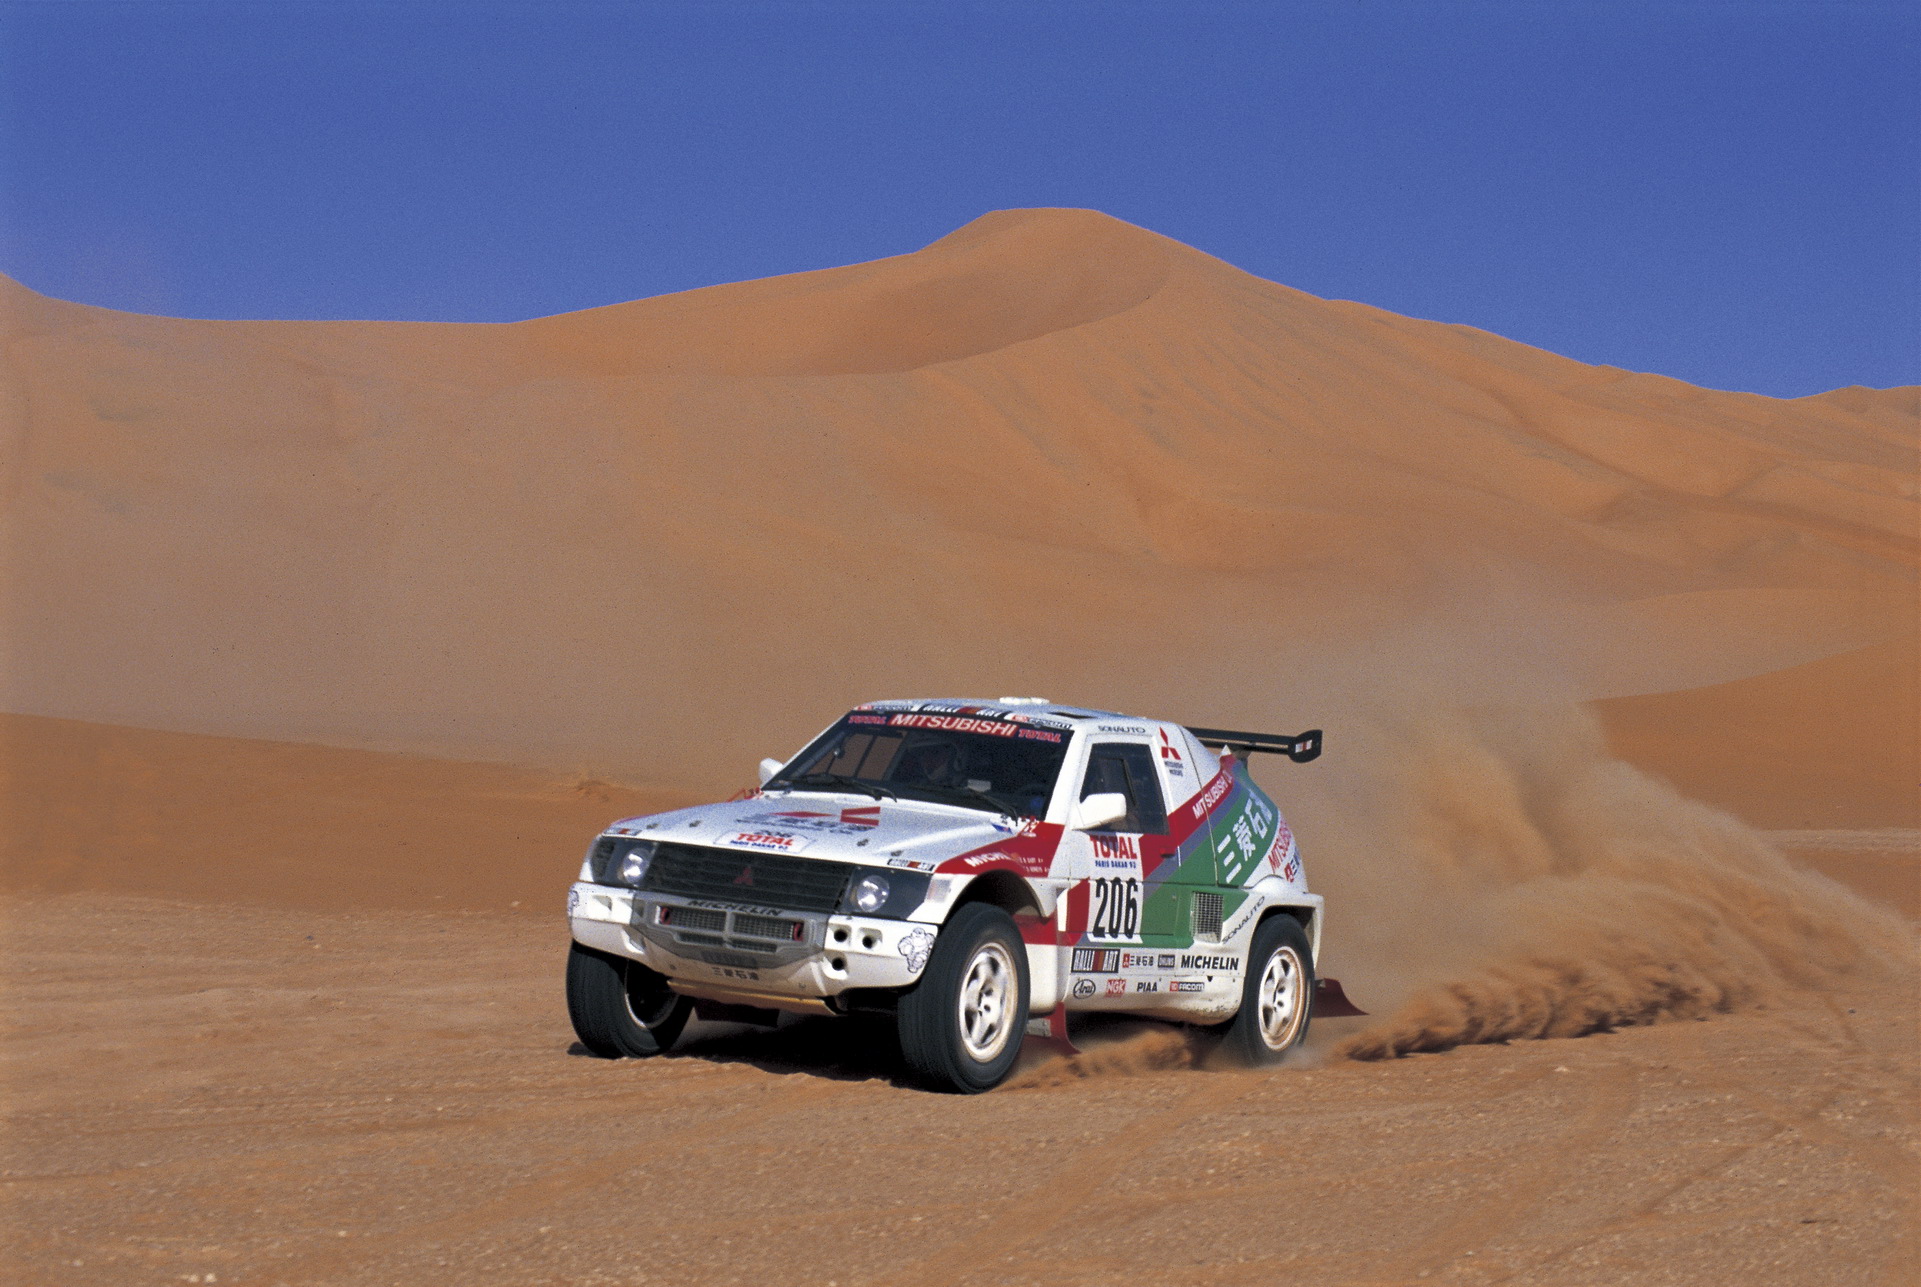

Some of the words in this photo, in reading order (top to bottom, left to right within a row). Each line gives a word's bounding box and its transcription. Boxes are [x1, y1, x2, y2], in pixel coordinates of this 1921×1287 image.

[890, 713, 1018, 737] MITSUBISHI
[1098, 725, 1147, 734] SONAUTO
[1018, 729, 1062, 743] TOTAL
[737, 833, 794, 846] TOTAL
[751, 842, 776, 850] DAKAR
[1090, 835, 1138, 859] TOTAL
[1095, 860, 1110, 868] PARIS
[1111, 861, 1128, 869] DAKAR
[687, 900, 783, 916] MICHELIN
[1093, 877, 1138, 939] 206
[1222, 896, 1265, 945] SONAUTO
[1073, 949, 1096, 972] RALLI
[1102, 950, 1119, 972] ART
[1181, 955, 1239, 970] MICHELIN
[1077, 980, 1094, 994] Arai
[1106, 980, 1125, 995] NGK
[1137, 982, 1158, 992] PIAA
